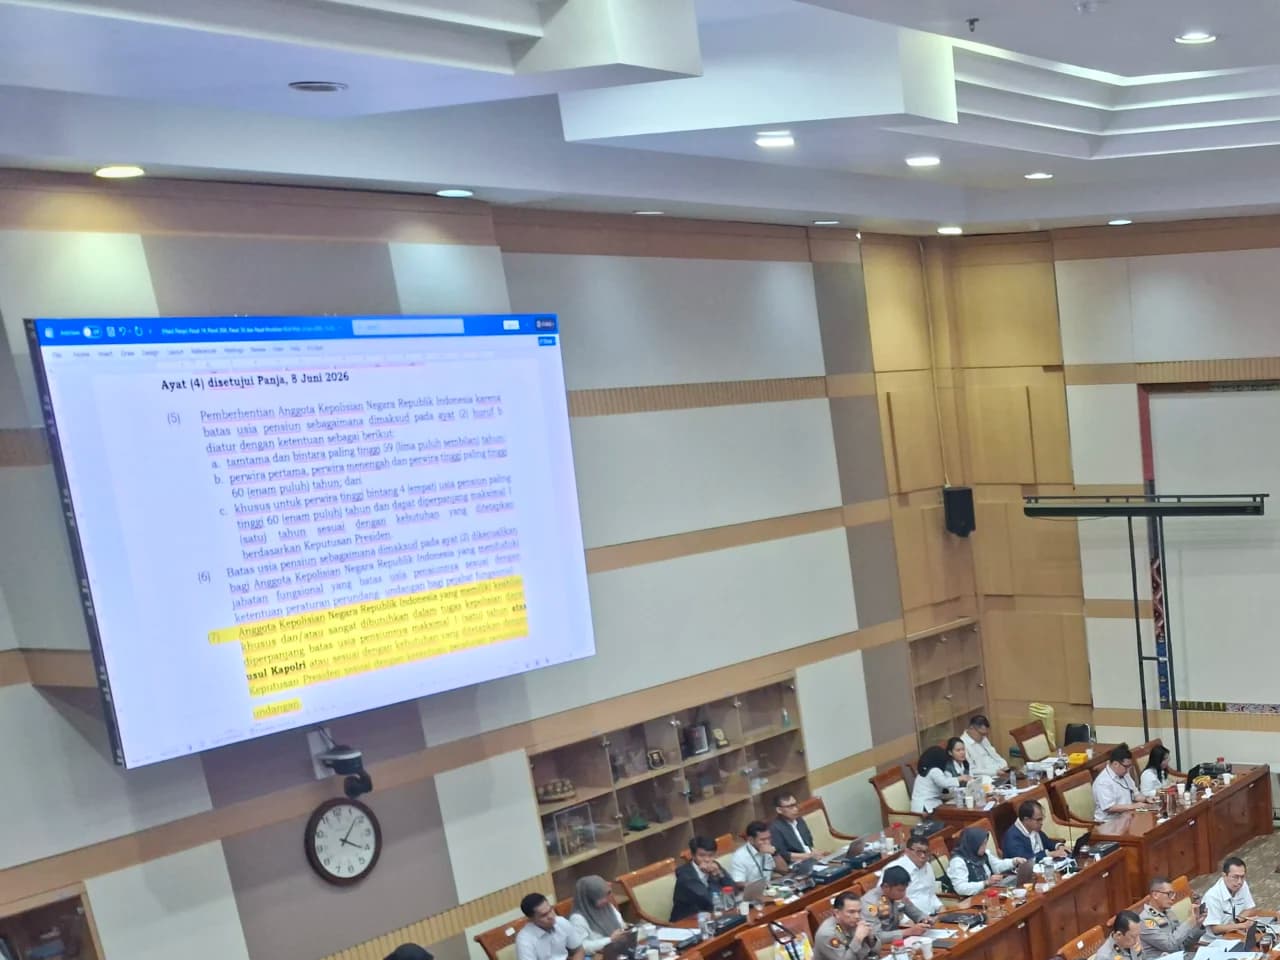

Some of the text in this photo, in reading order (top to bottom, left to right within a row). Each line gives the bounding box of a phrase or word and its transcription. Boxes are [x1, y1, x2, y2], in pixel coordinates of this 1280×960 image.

[160, 380, 187, 392] Ayat
[190, 379, 205, 391] (4)
[207, 377, 255, 388] disetujui
[257, 376, 288, 387] Panja,
[300, 374, 323, 383] Juni
[325, 372, 349, 382] 2026
[167, 413, 181, 425] (5)
[200, 408, 275, 420] Pemberhentian
[278, 406, 315, 417] Anggota
[317, 403, 364, 414] Kepolisian
[366, 401, 396, 411] Negara
[398, 397, 434, 409] Republik
[436, 396, 473, 405] Indonesia
[203, 428, 231, 437] batas
[237, 425, 257, 434] usia
[263, 423, 301, 435] pensiun
[307, 419, 364, 430] sebagaimana
[369, 414, 410, 425] dimaksud
[414, 412, 434, 423] pada
[438, 412, 454, 421] ayat
[206, 443, 236, 452] diatur
[239, 441, 274, 451] dengan
[277, 437, 324, 447] ketentuan
[327, 433, 359, 443] sebagai
[226, 457, 270, 467] tamtama
[272, 454, 290, 463] dan
[293, 452, 326, 461] bintara
[328, 448, 355, 460] paling
[357, 446, 381, 456] tinggi
[229, 471, 265, 484] perwira
[311, 464, 344, 476] perwira
[347, 458, 389, 470] menengah
[391, 458, 408, 466] dan
[409, 455, 439, 466] perwira
[440, 452, 462, 462] tinggi
[231, 488, 245, 497] 60
[280, 481, 310, 495] puluh)
[313, 479, 342, 489] tahun;
[344, 477, 362, 486] dan
[234, 503, 271, 513] khusus
[273, 497, 301, 509] untuk
[304, 495, 337, 507] perwira
[340, 491, 364, 502] tinggi
[366, 489, 399, 498] bintang
[237, 518, 264, 529] tinggi
[267, 515, 279, 525] 60
[345, 505, 371, 515] tahun
[373, 503, 390, 512] dan
[392, 500, 416, 510] dapat
[239, 532, 267, 545] (satu)
[278, 528, 306, 538] tahun
[317, 523, 345, 533] sesuai
[355, 519, 386, 529] dengan
[396, 511, 440, 523] kebutuhan
[242, 544, 301, 559] berdasarkan
[304, 538, 352, 551] Keputusan
[198, 571, 211, 584] (6)
[227, 568, 255, 577] Batas
[258, 563, 277, 573] usia
[281, 558, 317, 571] pensiun
[320, 550, 374, 564] sebagaimana
[377, 541, 418, 555] dimaksud
[420, 539, 439, 551] pada
[229, 582, 250, 593] bagi
[253, 577, 291, 589] Anggota
[295, 569, 341, 582] Kepolisian
[344, 564, 374, 574] Negara
[377, 556, 413, 569] Republik
[416, 550, 454, 563] Indonesia
[232, 596, 268, 610] jabatan
[276, 585, 324, 600] fungsional
[332, 582, 352, 593] yang
[359, 577, 382, 586] batas
[234, 608, 283, 623] ketentuan
[239, 624, 277, 637] Anggota
[279, 616, 325, 629] Kepolisian
[328, 609, 358, 620] Negara
[360, 600, 396, 614] Republik
[280, 630, 323, 644] dan/atau
[329, 623, 357, 634] sangat
[247, 668, 267, 680] usul
[271, 661, 306, 675] Kapolri
